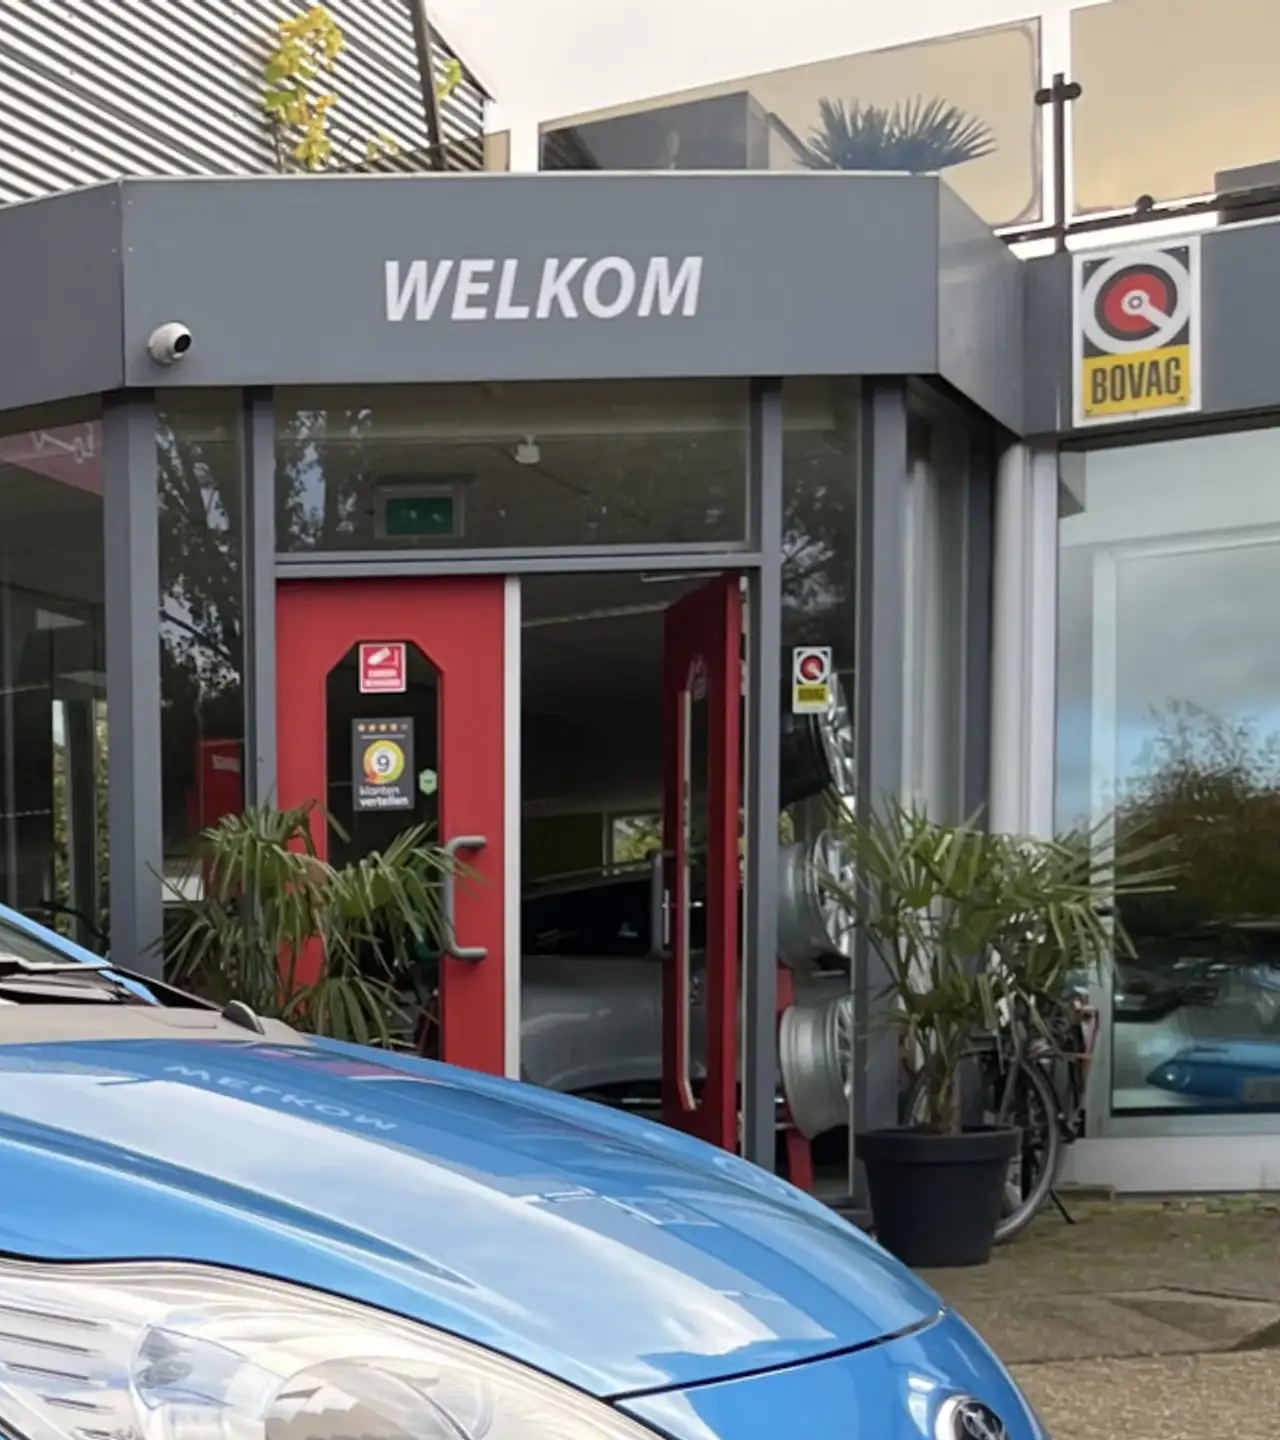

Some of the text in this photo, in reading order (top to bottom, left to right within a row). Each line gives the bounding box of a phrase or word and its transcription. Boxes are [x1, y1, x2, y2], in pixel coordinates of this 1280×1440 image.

[384, 255, 704, 322] WELKOM
[1091, 356, 1181, 404] BOVAG
[376, 754, 390, 773] 9
